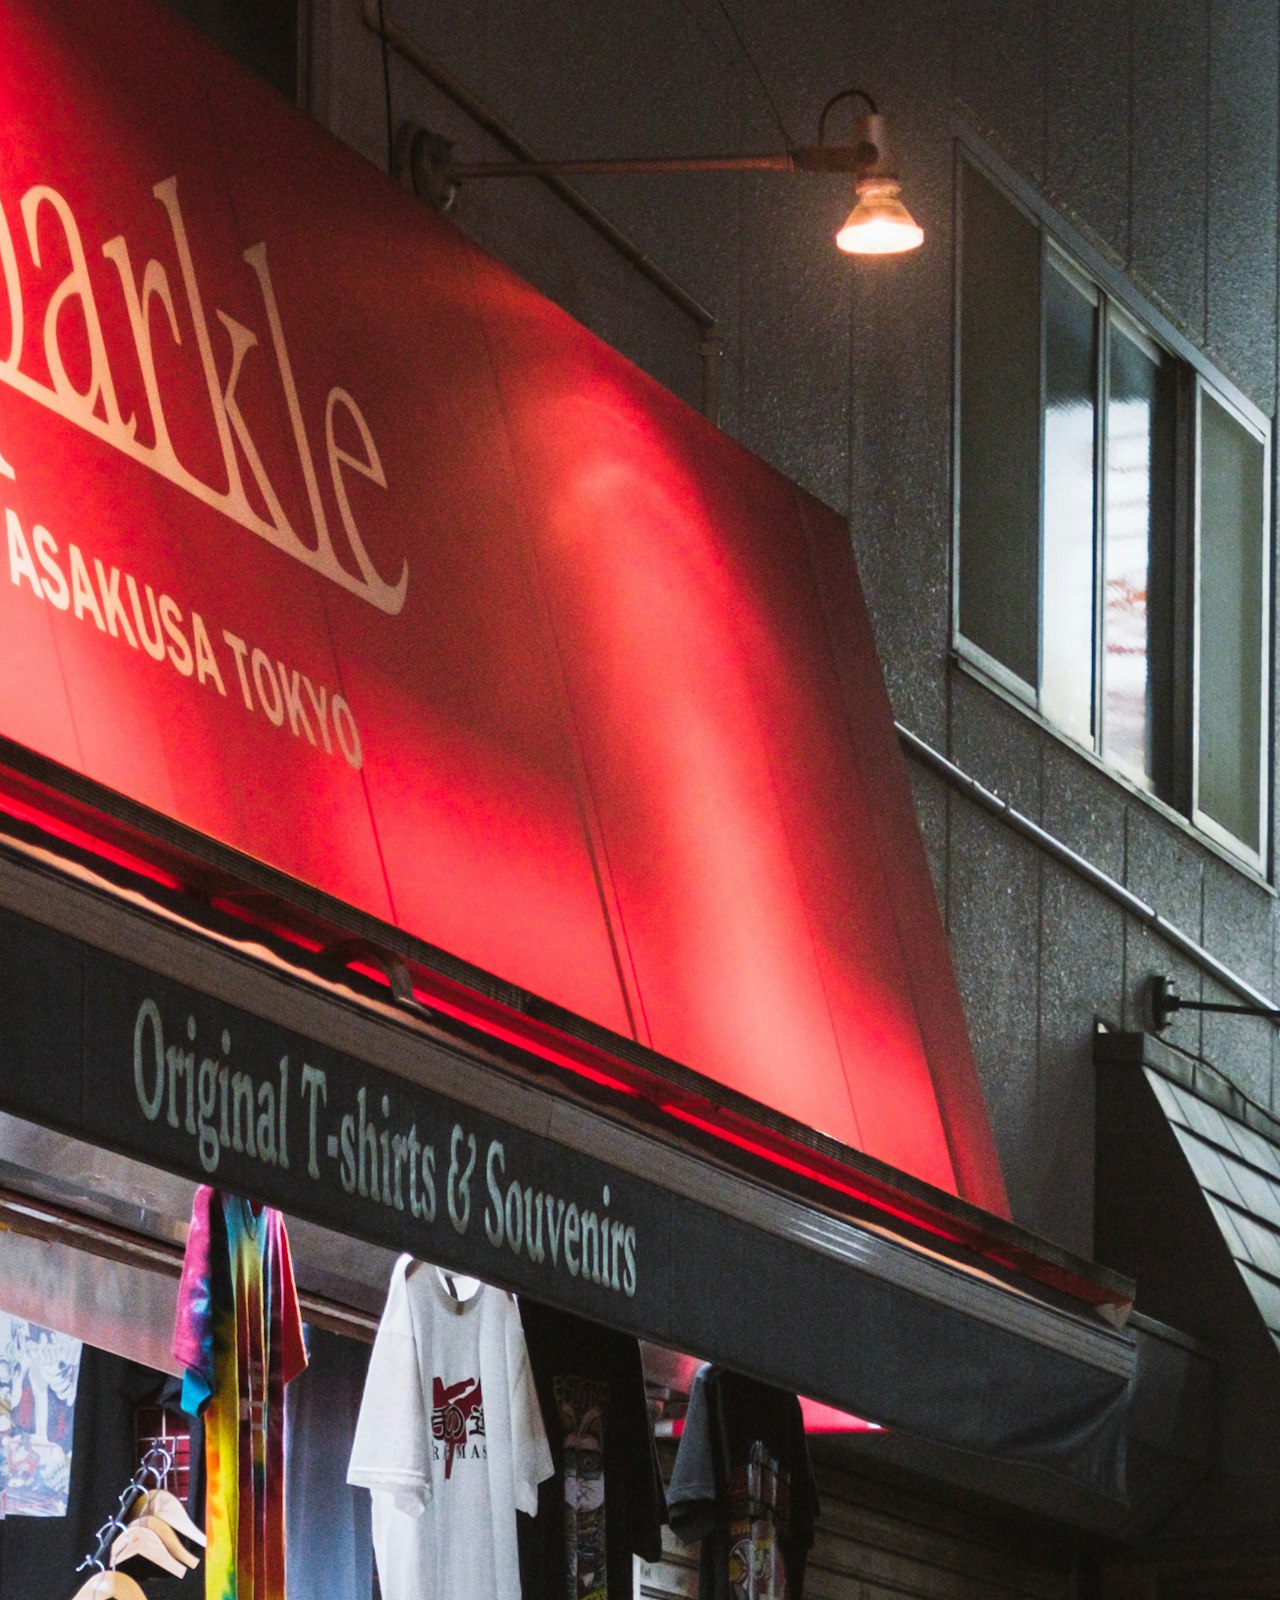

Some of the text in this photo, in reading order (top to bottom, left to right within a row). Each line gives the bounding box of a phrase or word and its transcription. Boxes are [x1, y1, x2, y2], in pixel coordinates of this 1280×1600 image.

[5, 507, 363, 771] ASAKUSA TOKYO
[133, 998, 636, 1297] Original T-shirts & Souvenirs
